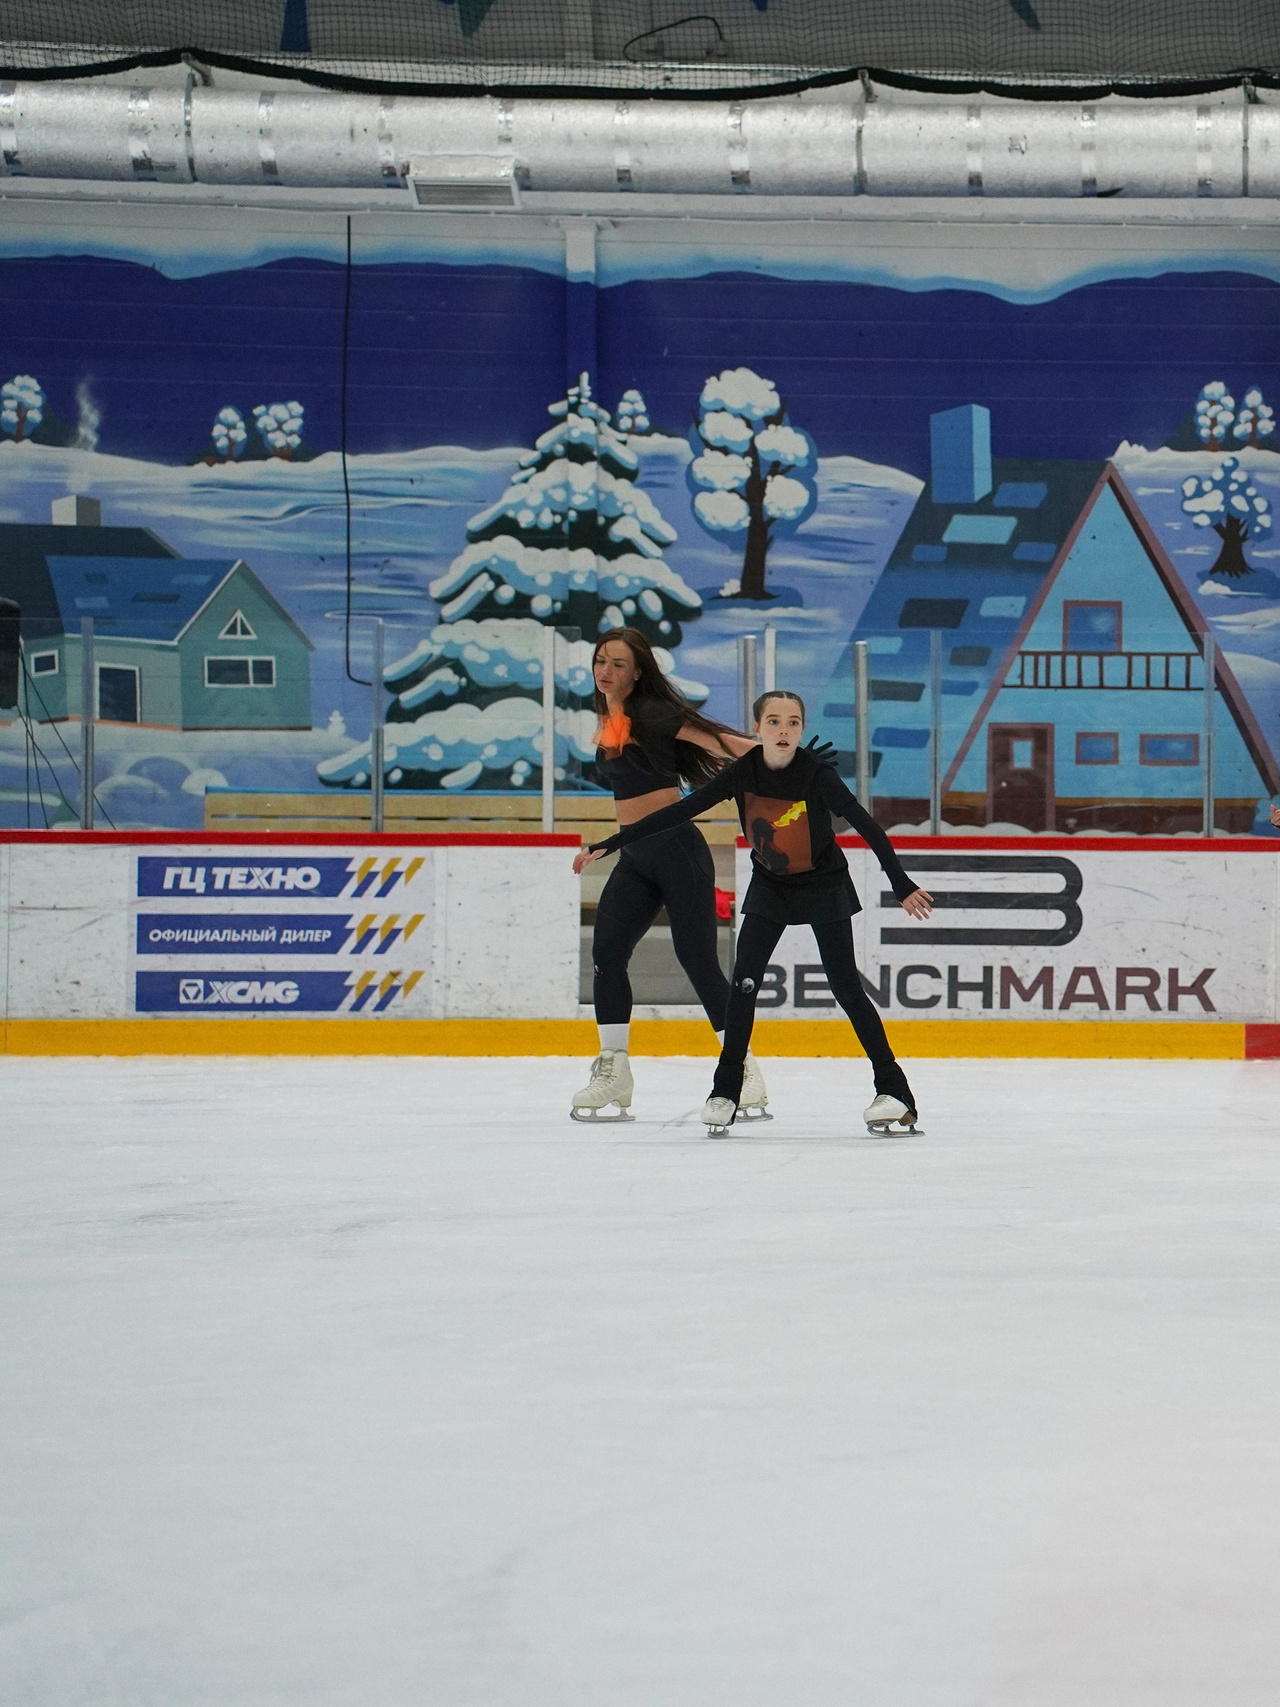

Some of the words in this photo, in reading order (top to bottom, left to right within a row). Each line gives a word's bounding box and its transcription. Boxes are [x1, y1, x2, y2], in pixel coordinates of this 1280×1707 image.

[162, 866, 206, 894] ГЦ
[212, 866, 321, 890] ТЕХНО
[149, 926, 277, 944] ОФИЦИАЛЬНЫЙ
[280, 929, 332, 945] ДИЛЕР
[203, 980, 300, 1004] XCMG
[753, 963, 1217, 1012] BENCHMARK
